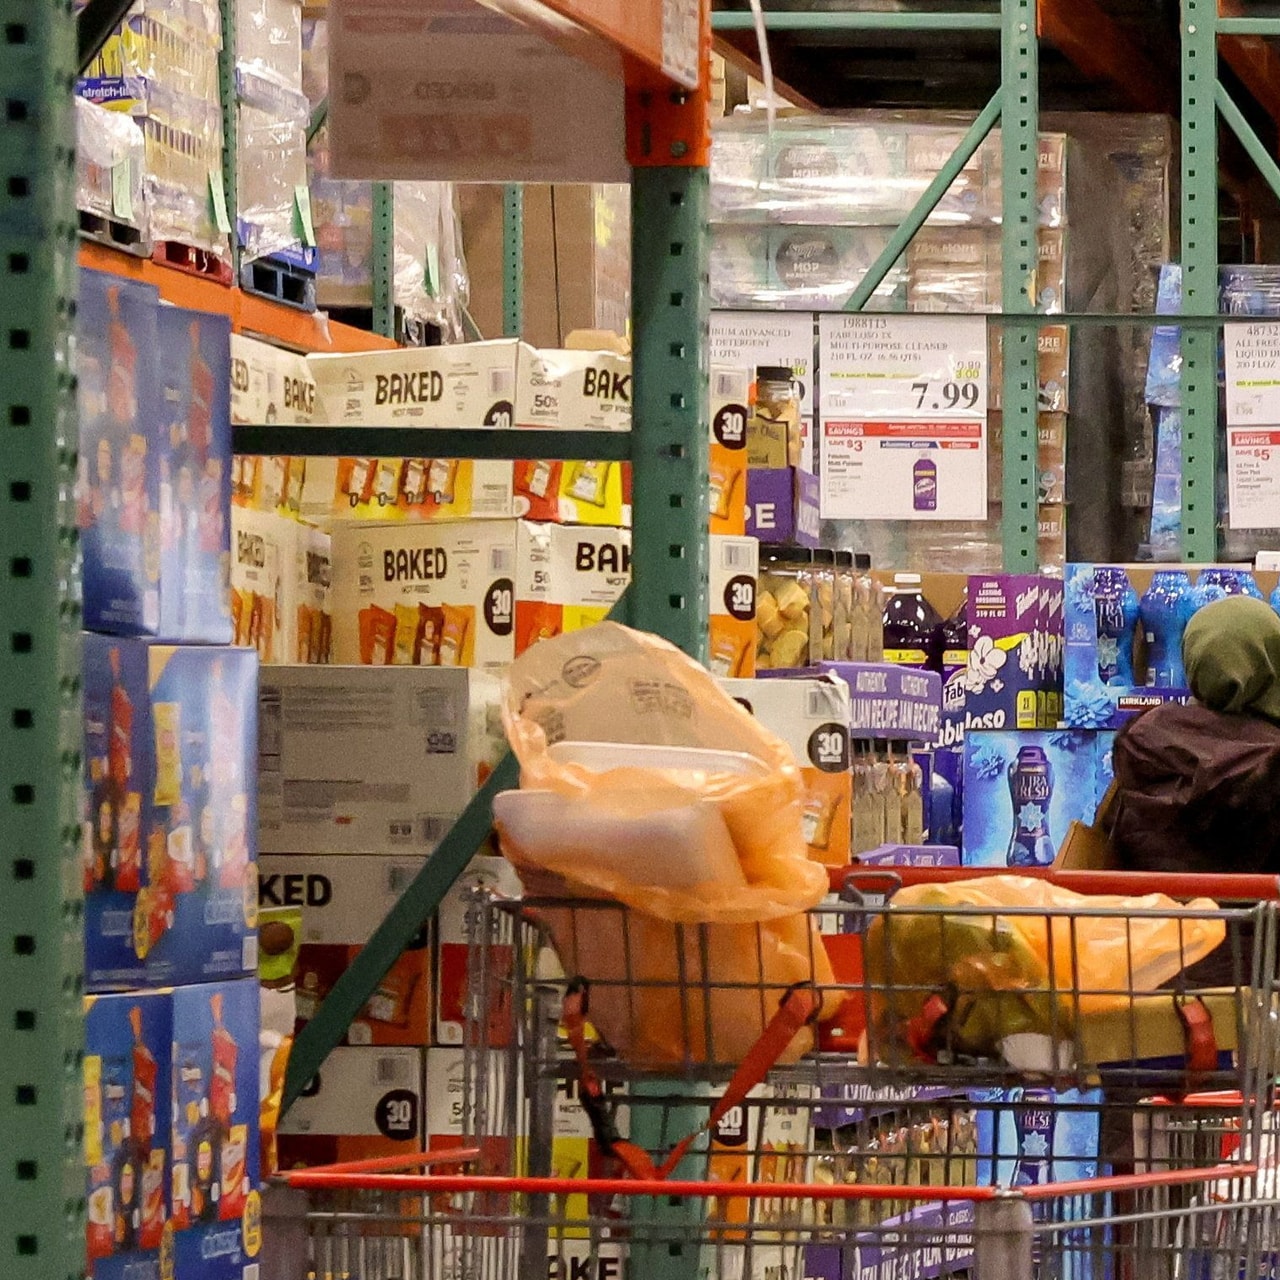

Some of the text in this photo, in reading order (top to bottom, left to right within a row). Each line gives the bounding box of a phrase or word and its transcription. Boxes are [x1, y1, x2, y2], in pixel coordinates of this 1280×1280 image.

[793, 263, 819, 272] MOP
[739, 328, 791, 337] ADVANCED
[843, 318, 887, 328] 1988113
[715, 339, 770, 347] DETERGENT
[830, 331, 878, 339] FABULOSO
[1236, 339, 1254, 347] ALL
[1235, 350, 1268, 358] LIQUID
[375, 371, 443, 405] BAKED
[911, 383, 979, 409] 7.99
[722, 412, 744, 434] 30
[384, 547, 447, 582] BAKED
[491, 590, 511, 615] 30
[732, 583, 753, 604] 30
[1119, 697, 1162, 706] KIRKLAND
[817, 733, 843, 755] 30
[259, 874, 332, 906] KED
[387, 1100, 411, 1123] 30
